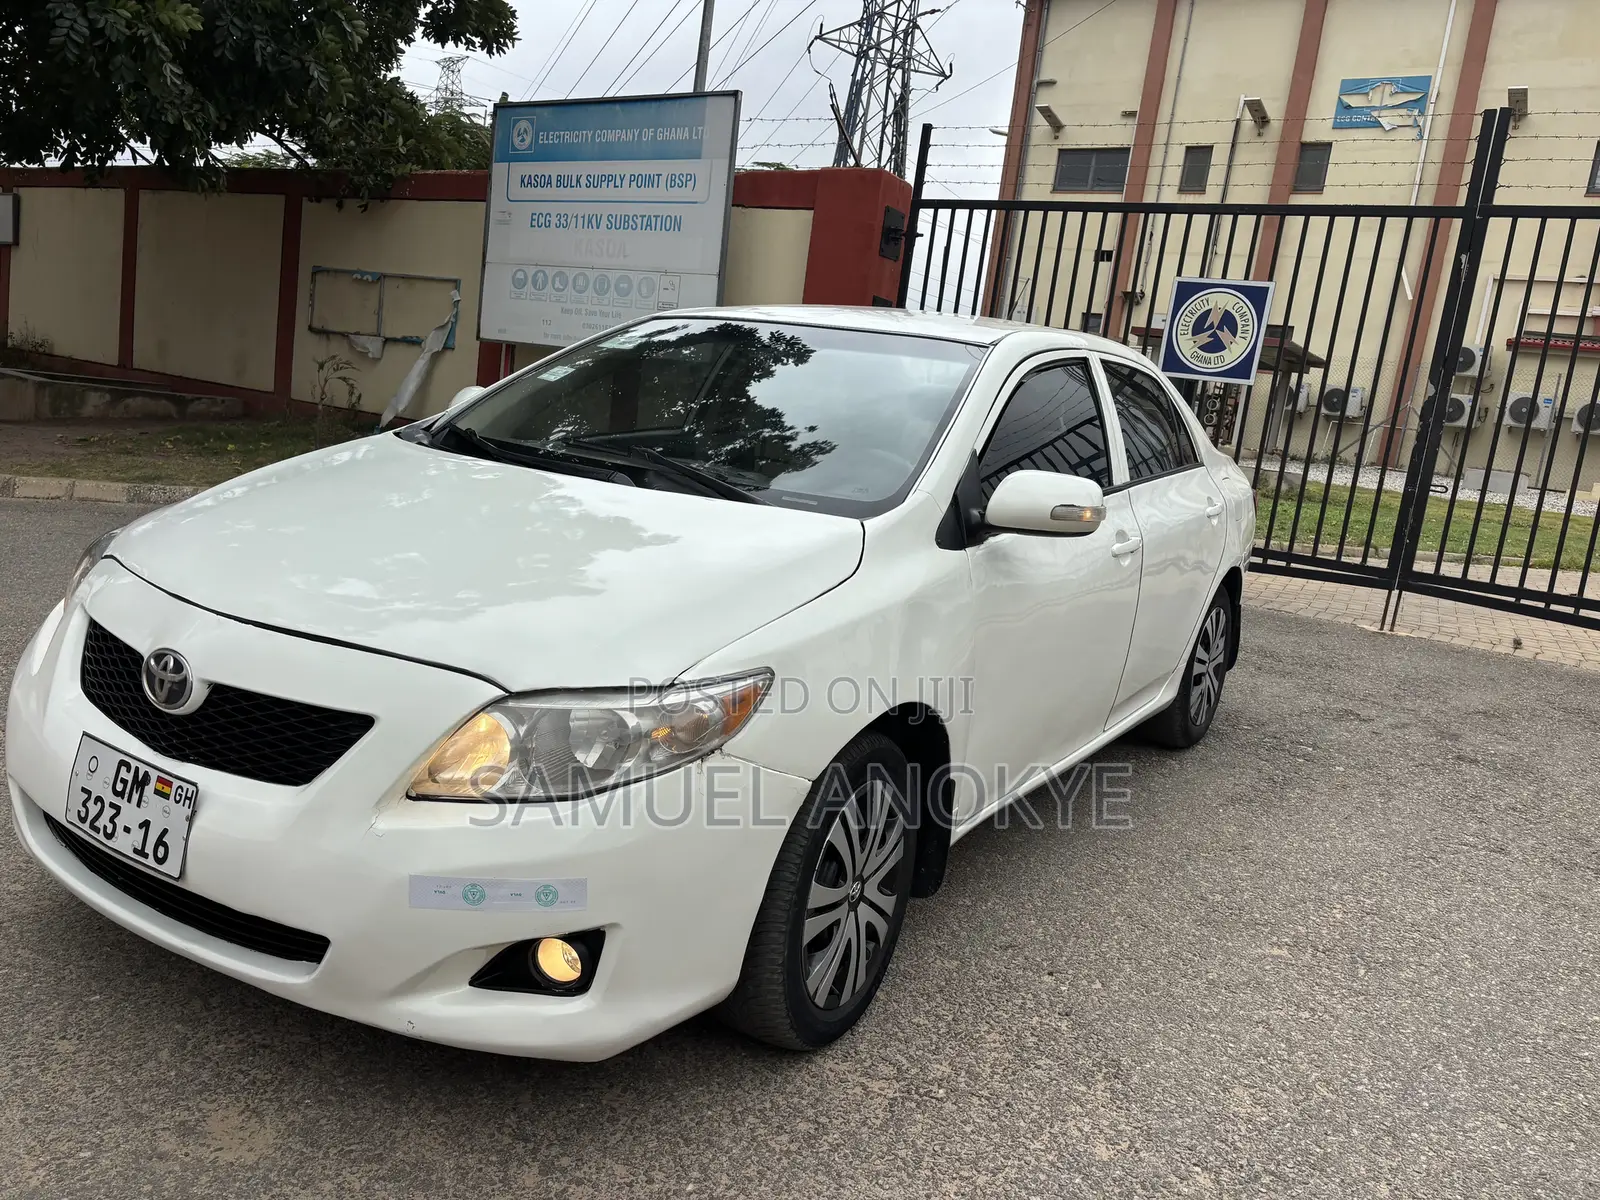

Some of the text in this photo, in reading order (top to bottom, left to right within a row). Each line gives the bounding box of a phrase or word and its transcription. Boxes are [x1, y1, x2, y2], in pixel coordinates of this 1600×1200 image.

[538, 130, 593, 145] ELECTRICITY
[595, 128, 639, 142] COMPANY
[642, 128, 654, 141] OF
[657, 126, 689, 141] GHANA
[520, 173, 697, 191] KASOA BULK SUPPLY POINT (BSP)
[530, 212, 552, 229] ECG
[554, 212, 603, 231] 33/11KV
[606, 214, 683, 232] SUBSTATION
[1180, 297, 1210, 336] ELECTRICITY
[1232, 301, 1251, 341] COMPANY
[1190, 350, 1226, 366] GHANA LTD
[112, 759, 194, 809] GM GH
[77, 786, 169, 865] 323-16
